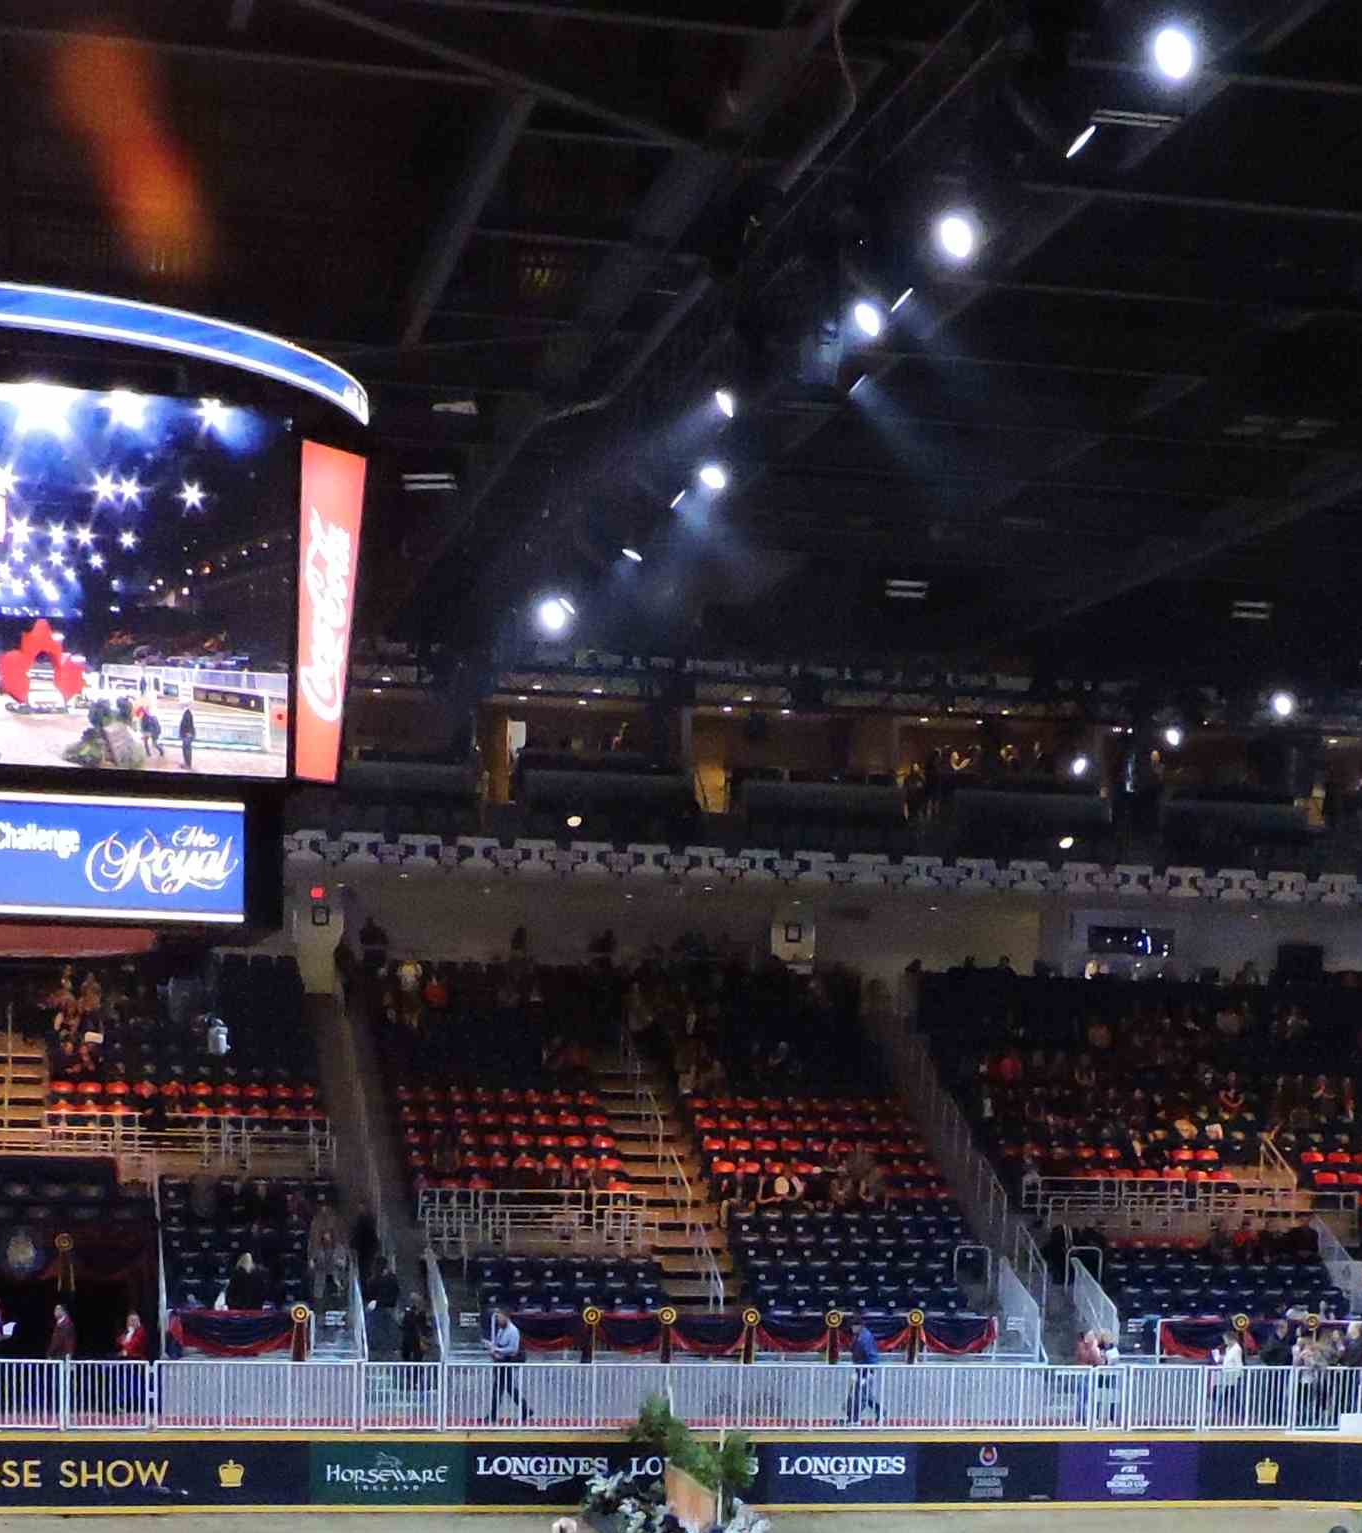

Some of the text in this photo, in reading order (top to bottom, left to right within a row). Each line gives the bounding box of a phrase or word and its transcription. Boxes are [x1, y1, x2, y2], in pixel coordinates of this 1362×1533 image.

[172, 825, 220, 848] The
[85, 827, 239, 894] Royal
[59, 1460, 169, 1488] SHOW
[477, 1456, 609, 1476] LONGINES
[779, 1456, 906, 1475] LONGINES
